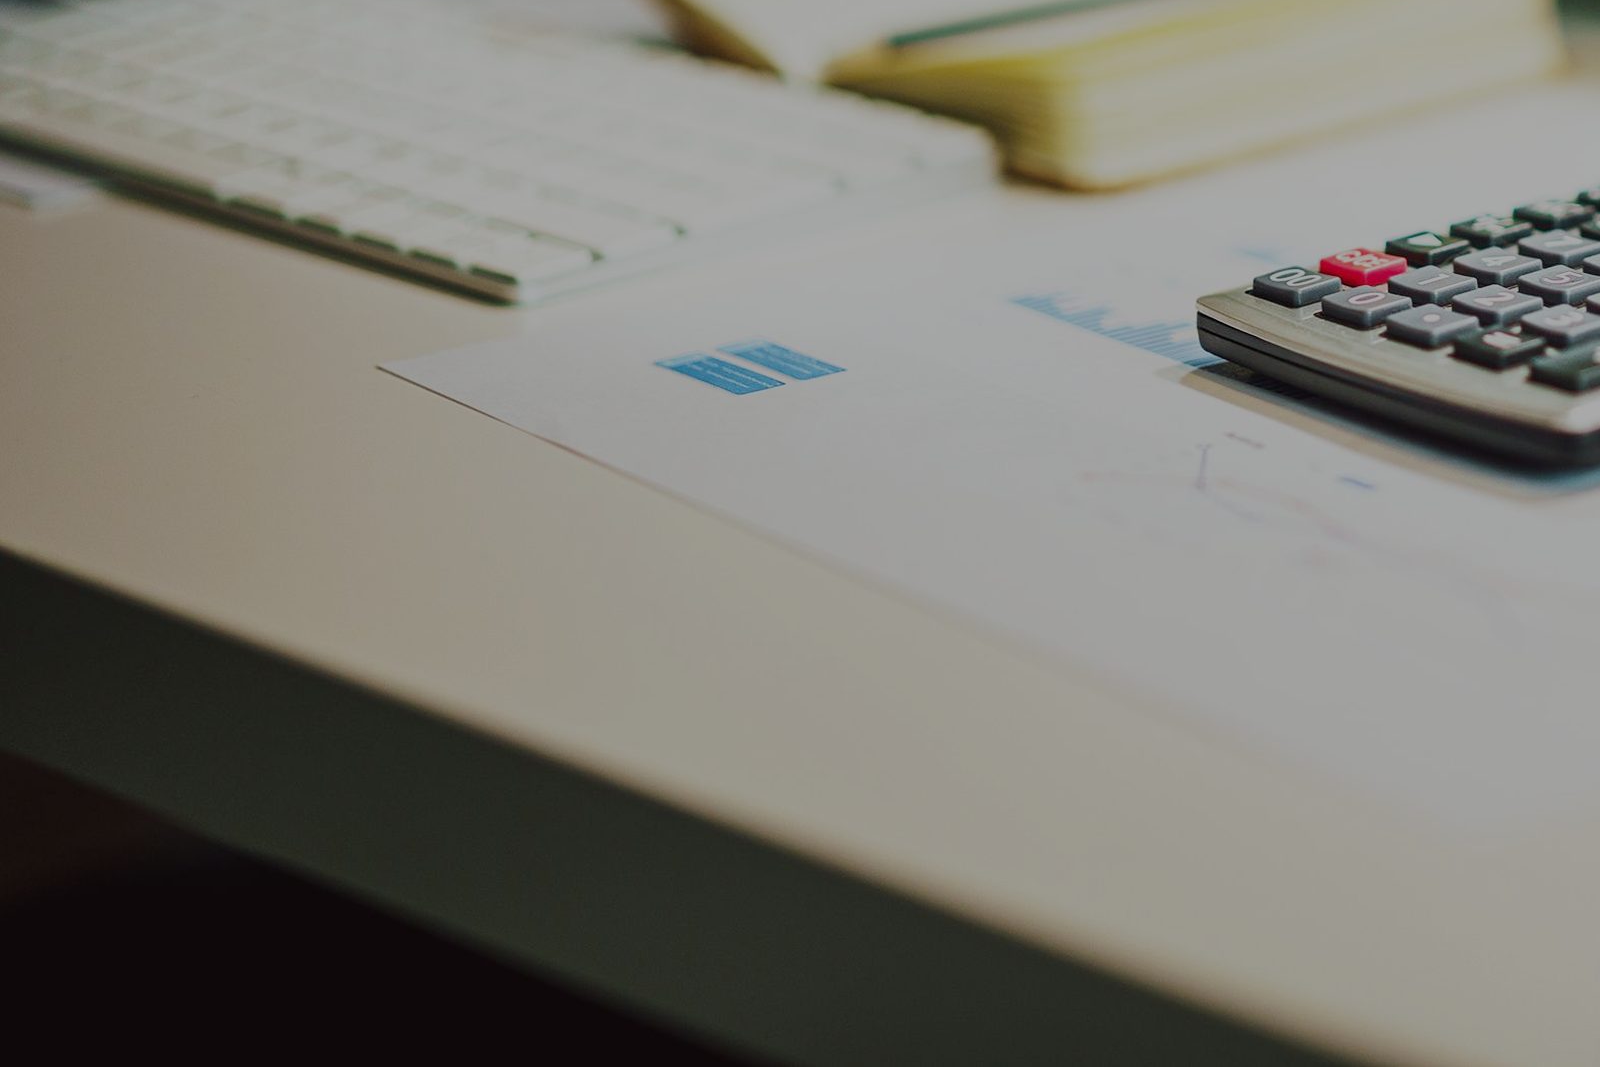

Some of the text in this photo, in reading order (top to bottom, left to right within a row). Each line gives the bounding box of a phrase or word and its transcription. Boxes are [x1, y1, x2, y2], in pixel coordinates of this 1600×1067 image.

[1545, 236, 1584, 247] 7
[1481, 255, 1517, 267] 4
[1269, 268, 1323, 287] 00
[1420, 273, 1449, 285] 1
[1543, 271, 1584, 285] 5
[1348, 292, 1386, 305] 0
[1474, 292, 1515, 306] 2
[1546, 312, 1584, 327] 3
